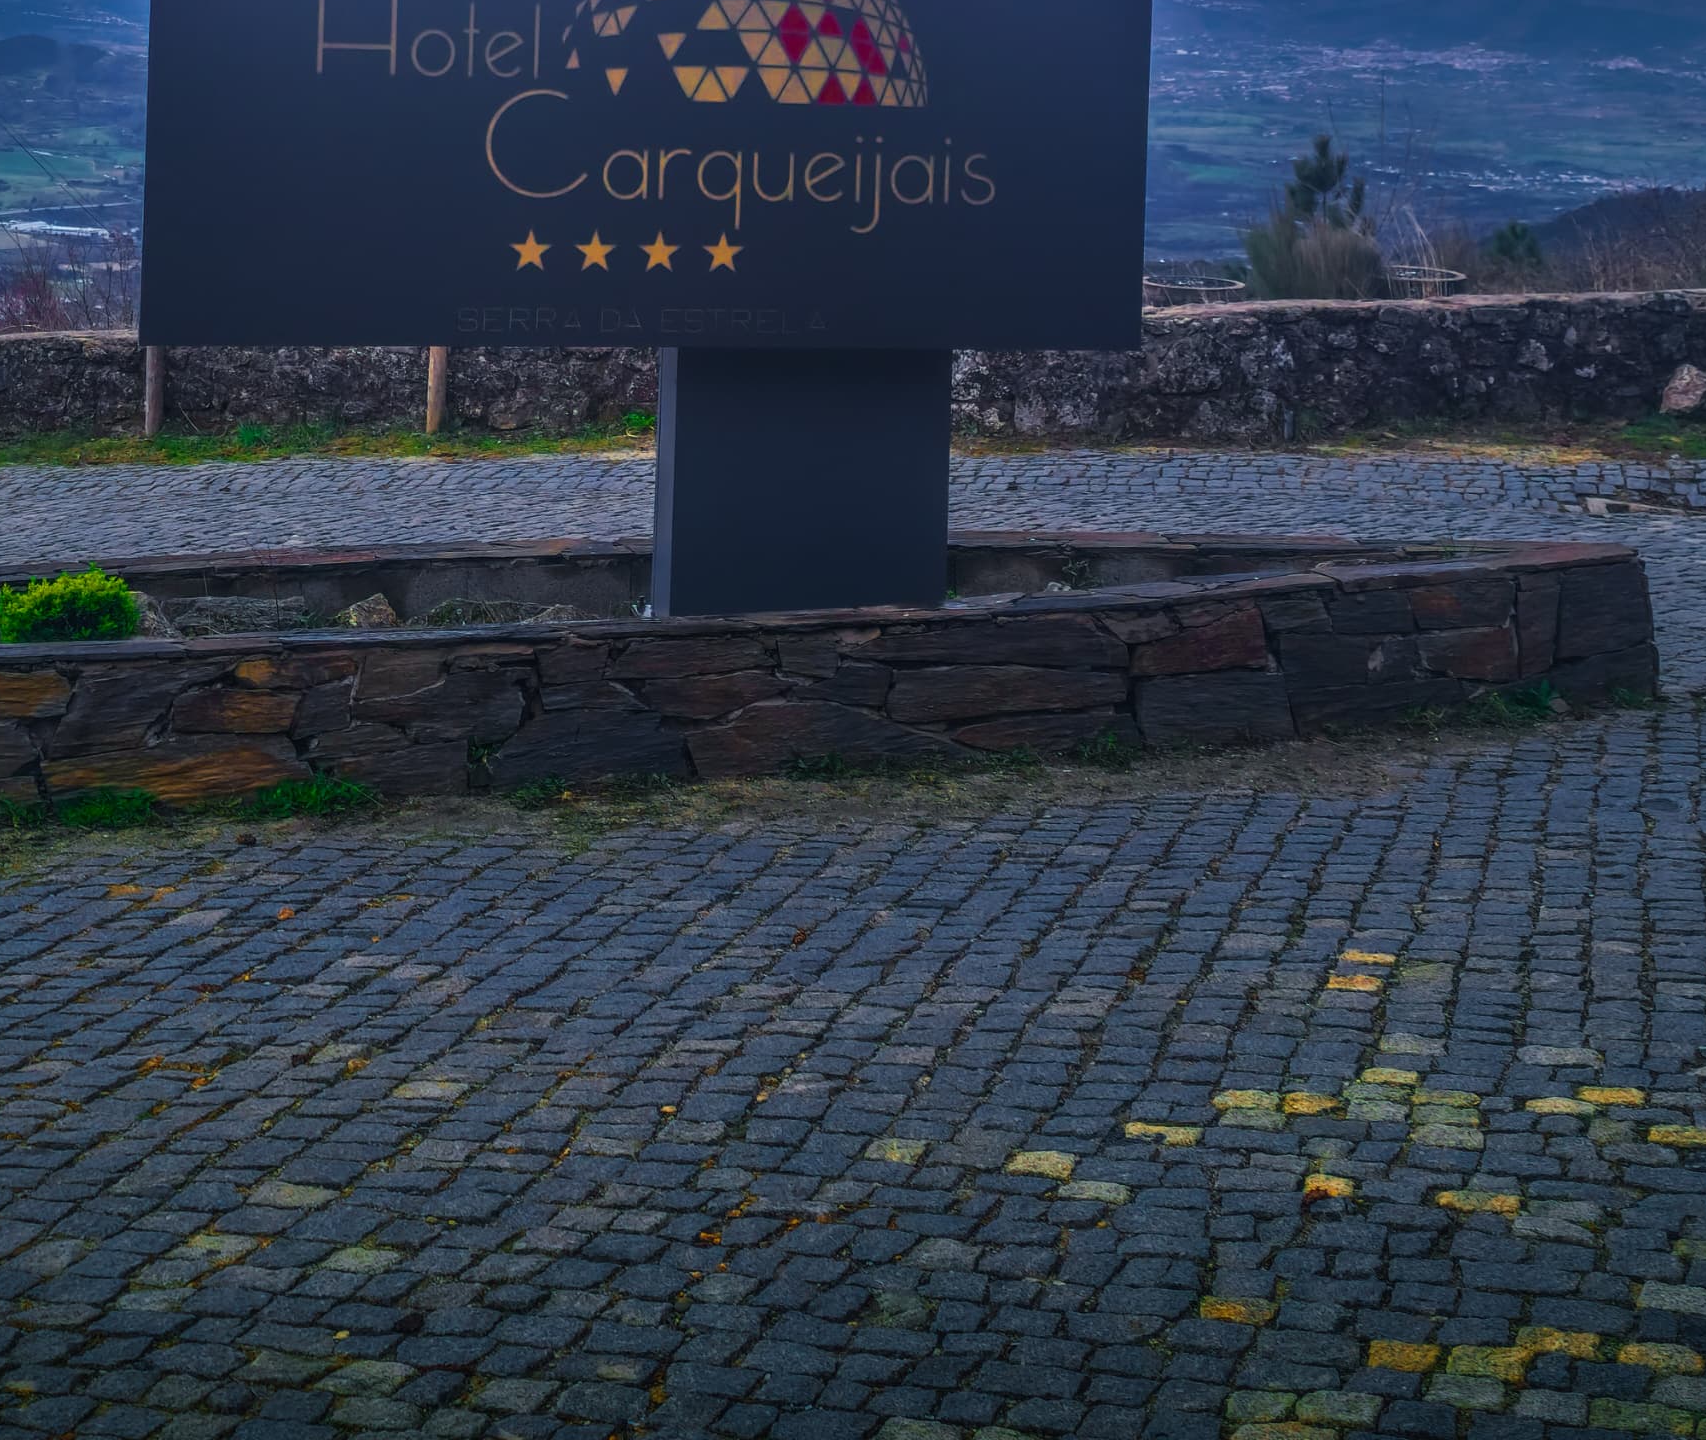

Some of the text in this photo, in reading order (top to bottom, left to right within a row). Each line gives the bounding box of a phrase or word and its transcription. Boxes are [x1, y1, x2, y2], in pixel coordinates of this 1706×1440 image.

[486, 89, 995, 234] Carqueijais
[455, 305, 829, 336] SERRA DA ESTRELA
